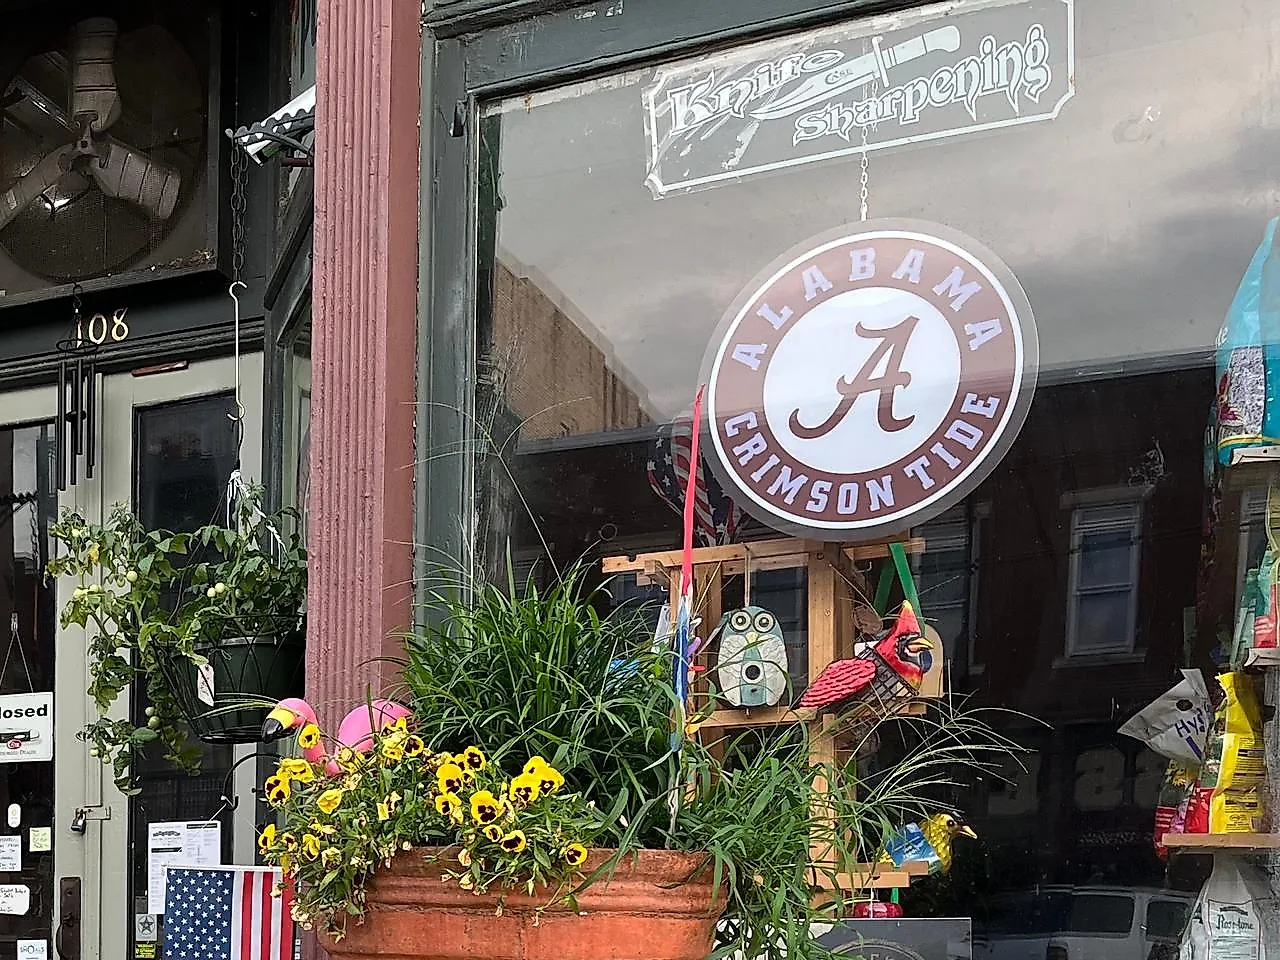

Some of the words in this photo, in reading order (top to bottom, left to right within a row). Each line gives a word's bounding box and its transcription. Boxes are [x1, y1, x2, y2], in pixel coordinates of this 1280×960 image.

[670, 49, 846, 136] Knife
[793, 23, 1052, 147] Sharpening
[76, 306, 129, 346] 108
[731, 247, 1004, 371] ALABAMA
[723, 411, 896, 515] CRIMSON
[903, 392, 1001, 491] TIDE
